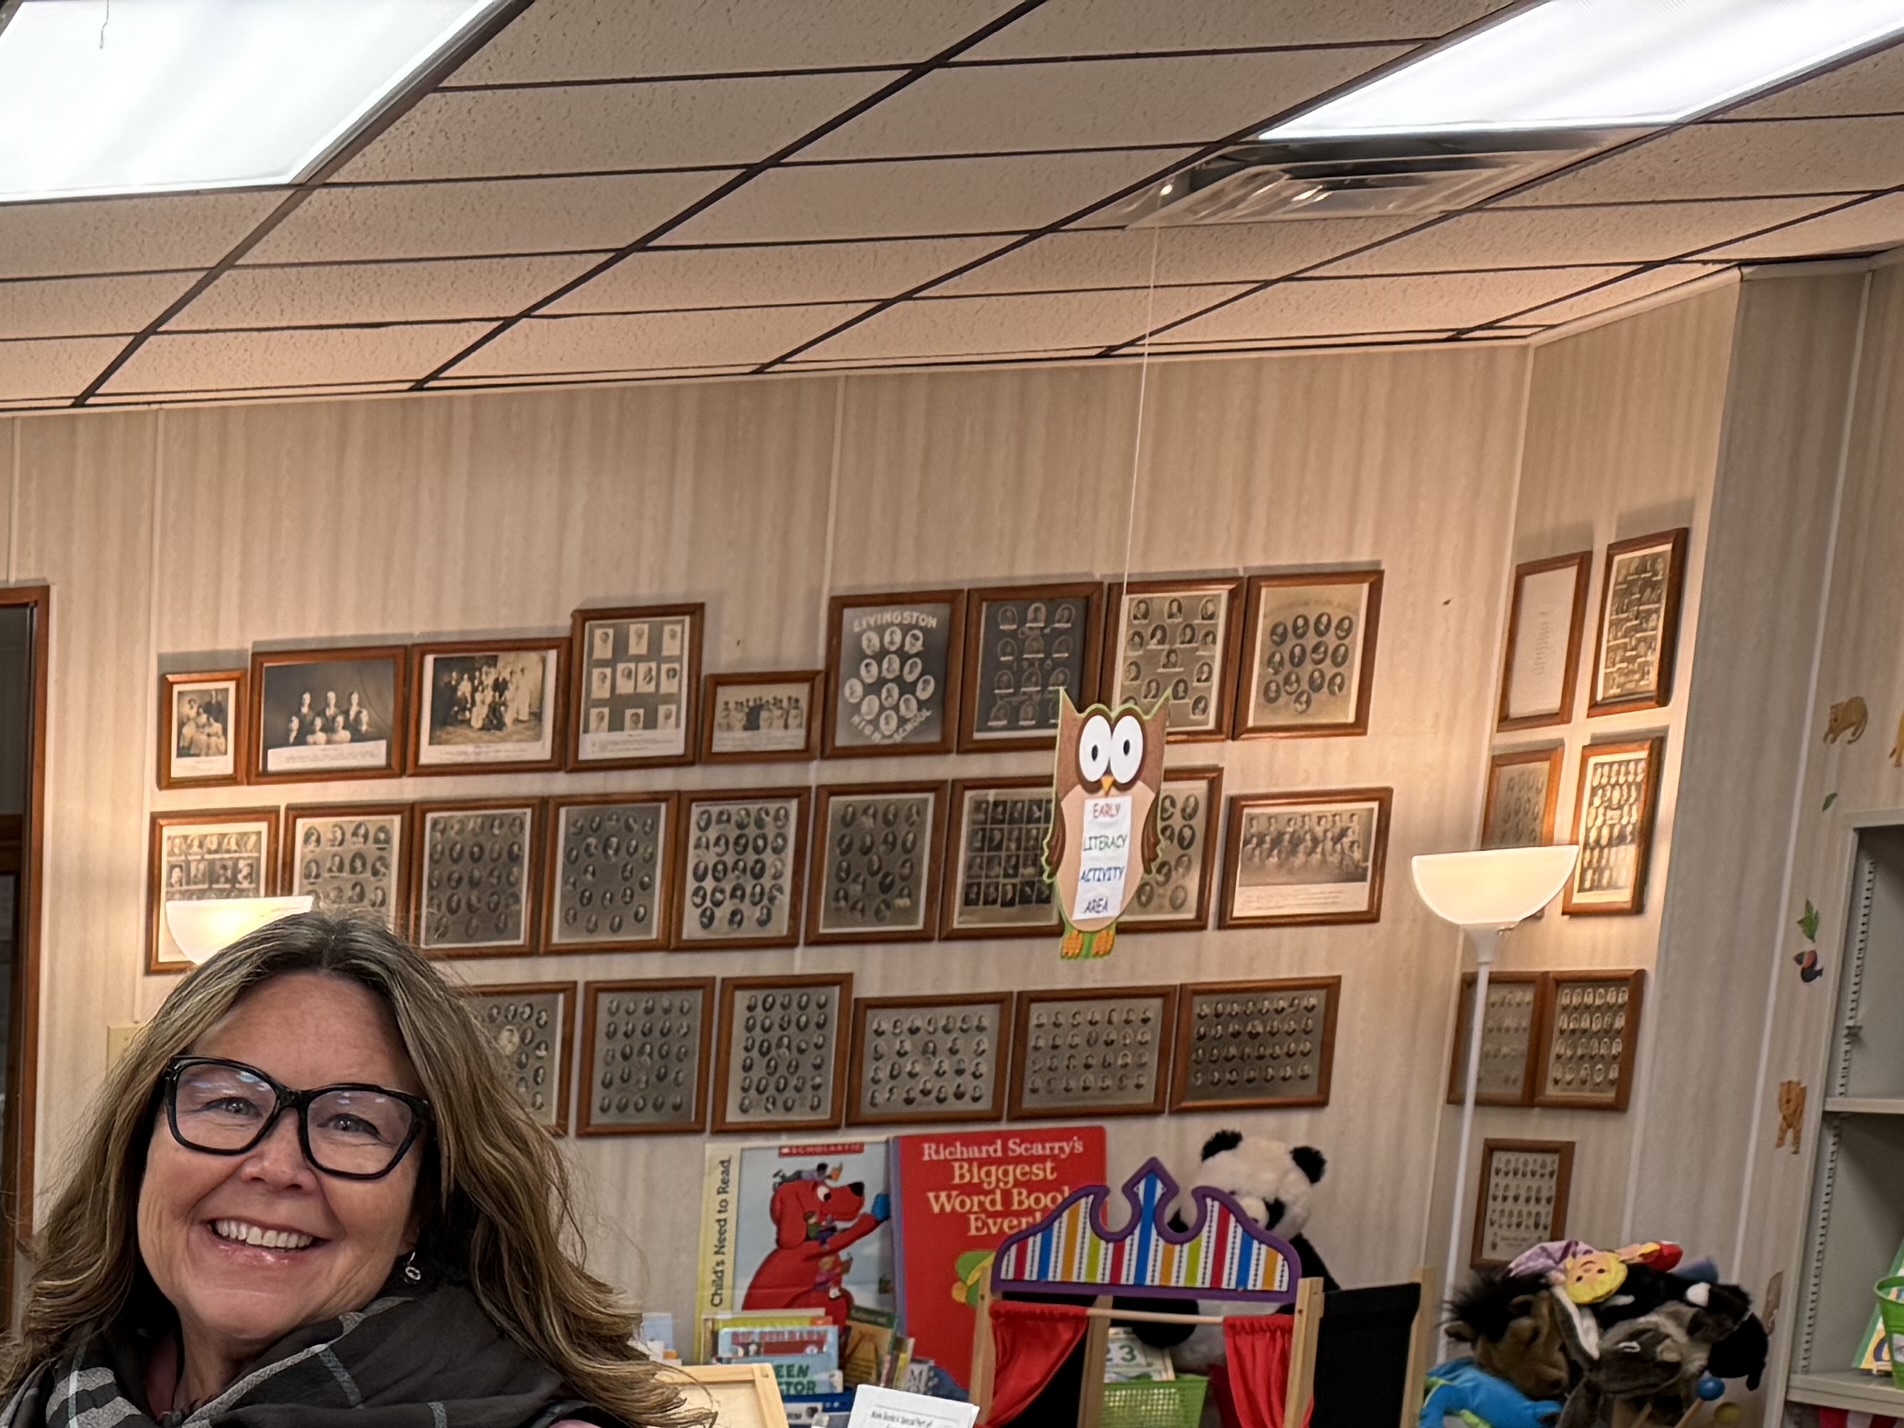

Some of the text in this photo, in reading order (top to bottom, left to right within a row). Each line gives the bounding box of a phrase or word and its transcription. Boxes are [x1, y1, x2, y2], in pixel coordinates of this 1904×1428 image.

[853, 609, 938, 632] LIVINGSTON
[1093, 803, 1121, 819] EARLY
[1082, 834, 1128, 851] LITERACY
[1079, 866, 1126, 883] ACTIVITY
[1083, 897, 1110, 914] AREA
[922, 1137, 1083, 1161] Richard Scarry's
[951, 1160, 1058, 1189] Biggest
[927, 1189, 1002, 1215] Word
[711, 1156, 731, 1307] Child's Need Read
